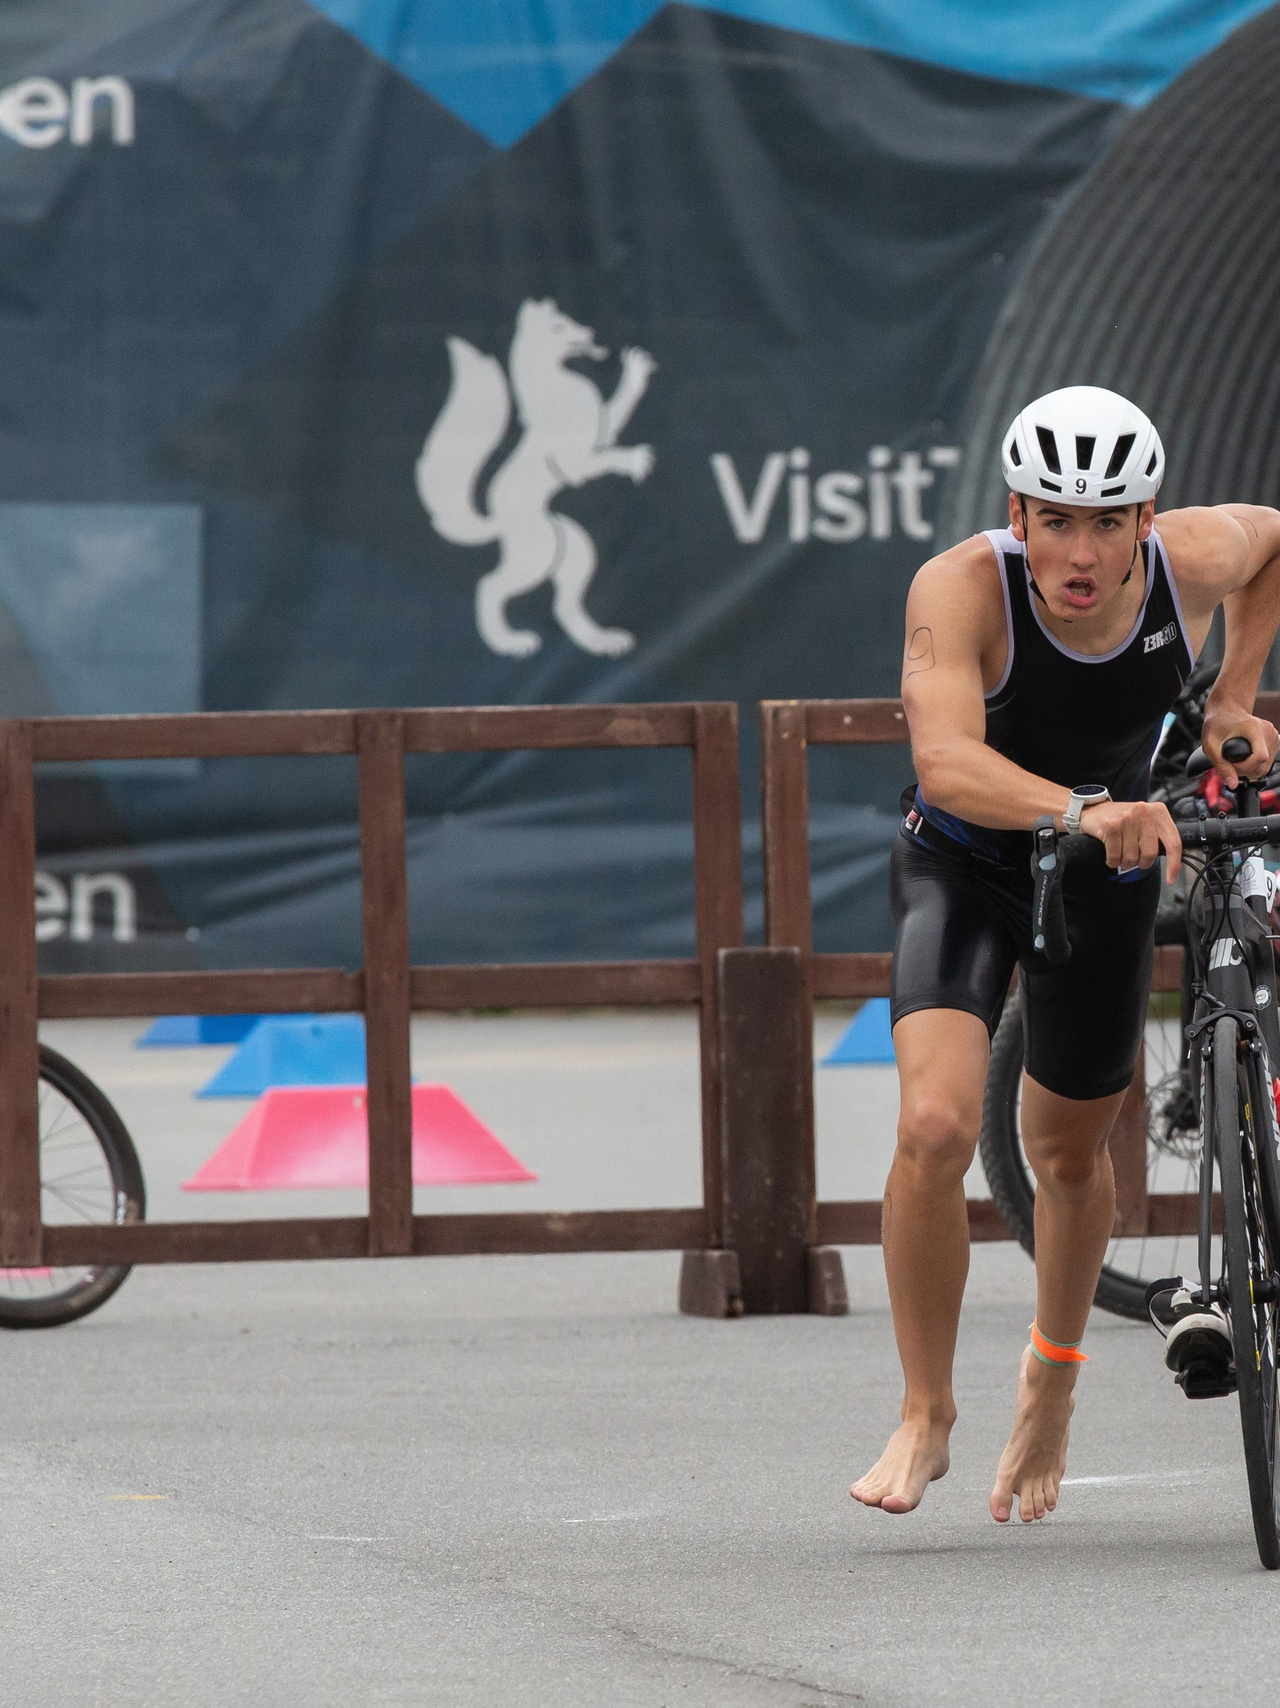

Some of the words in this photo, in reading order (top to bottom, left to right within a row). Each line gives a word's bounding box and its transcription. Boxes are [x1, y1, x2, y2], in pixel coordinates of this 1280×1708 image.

[711, 447, 960, 543] Visit
[1074, 478, 1087, 494] 9
[1266, 876, 1273, 901] 9
